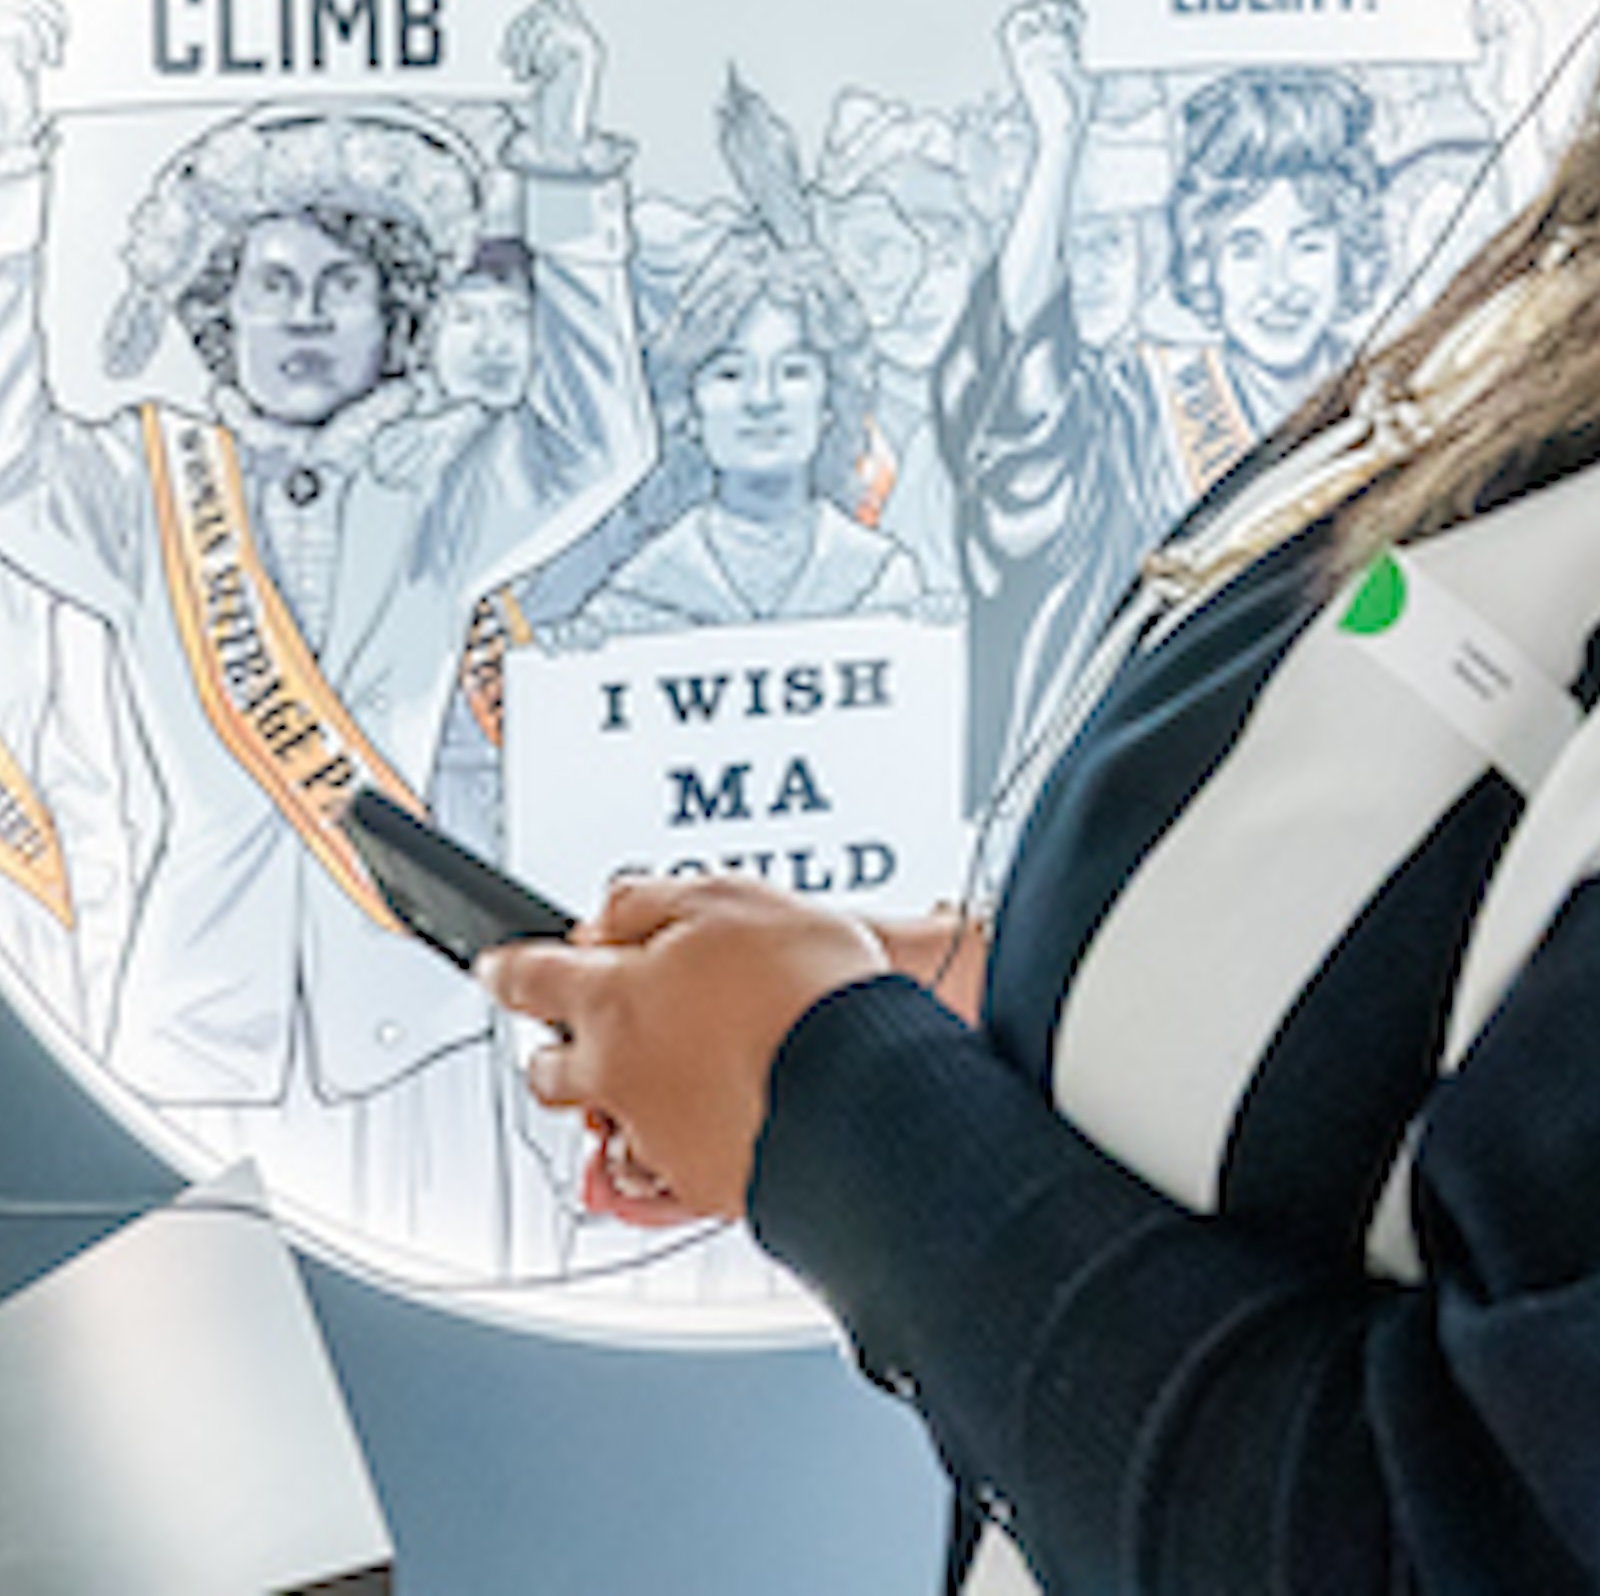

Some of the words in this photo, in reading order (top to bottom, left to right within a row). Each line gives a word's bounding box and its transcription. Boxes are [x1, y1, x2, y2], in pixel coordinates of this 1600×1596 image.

[599, 682, 631, 732] I
[657, 659, 891, 725] WISH
[665, 757, 832, 826] MA
